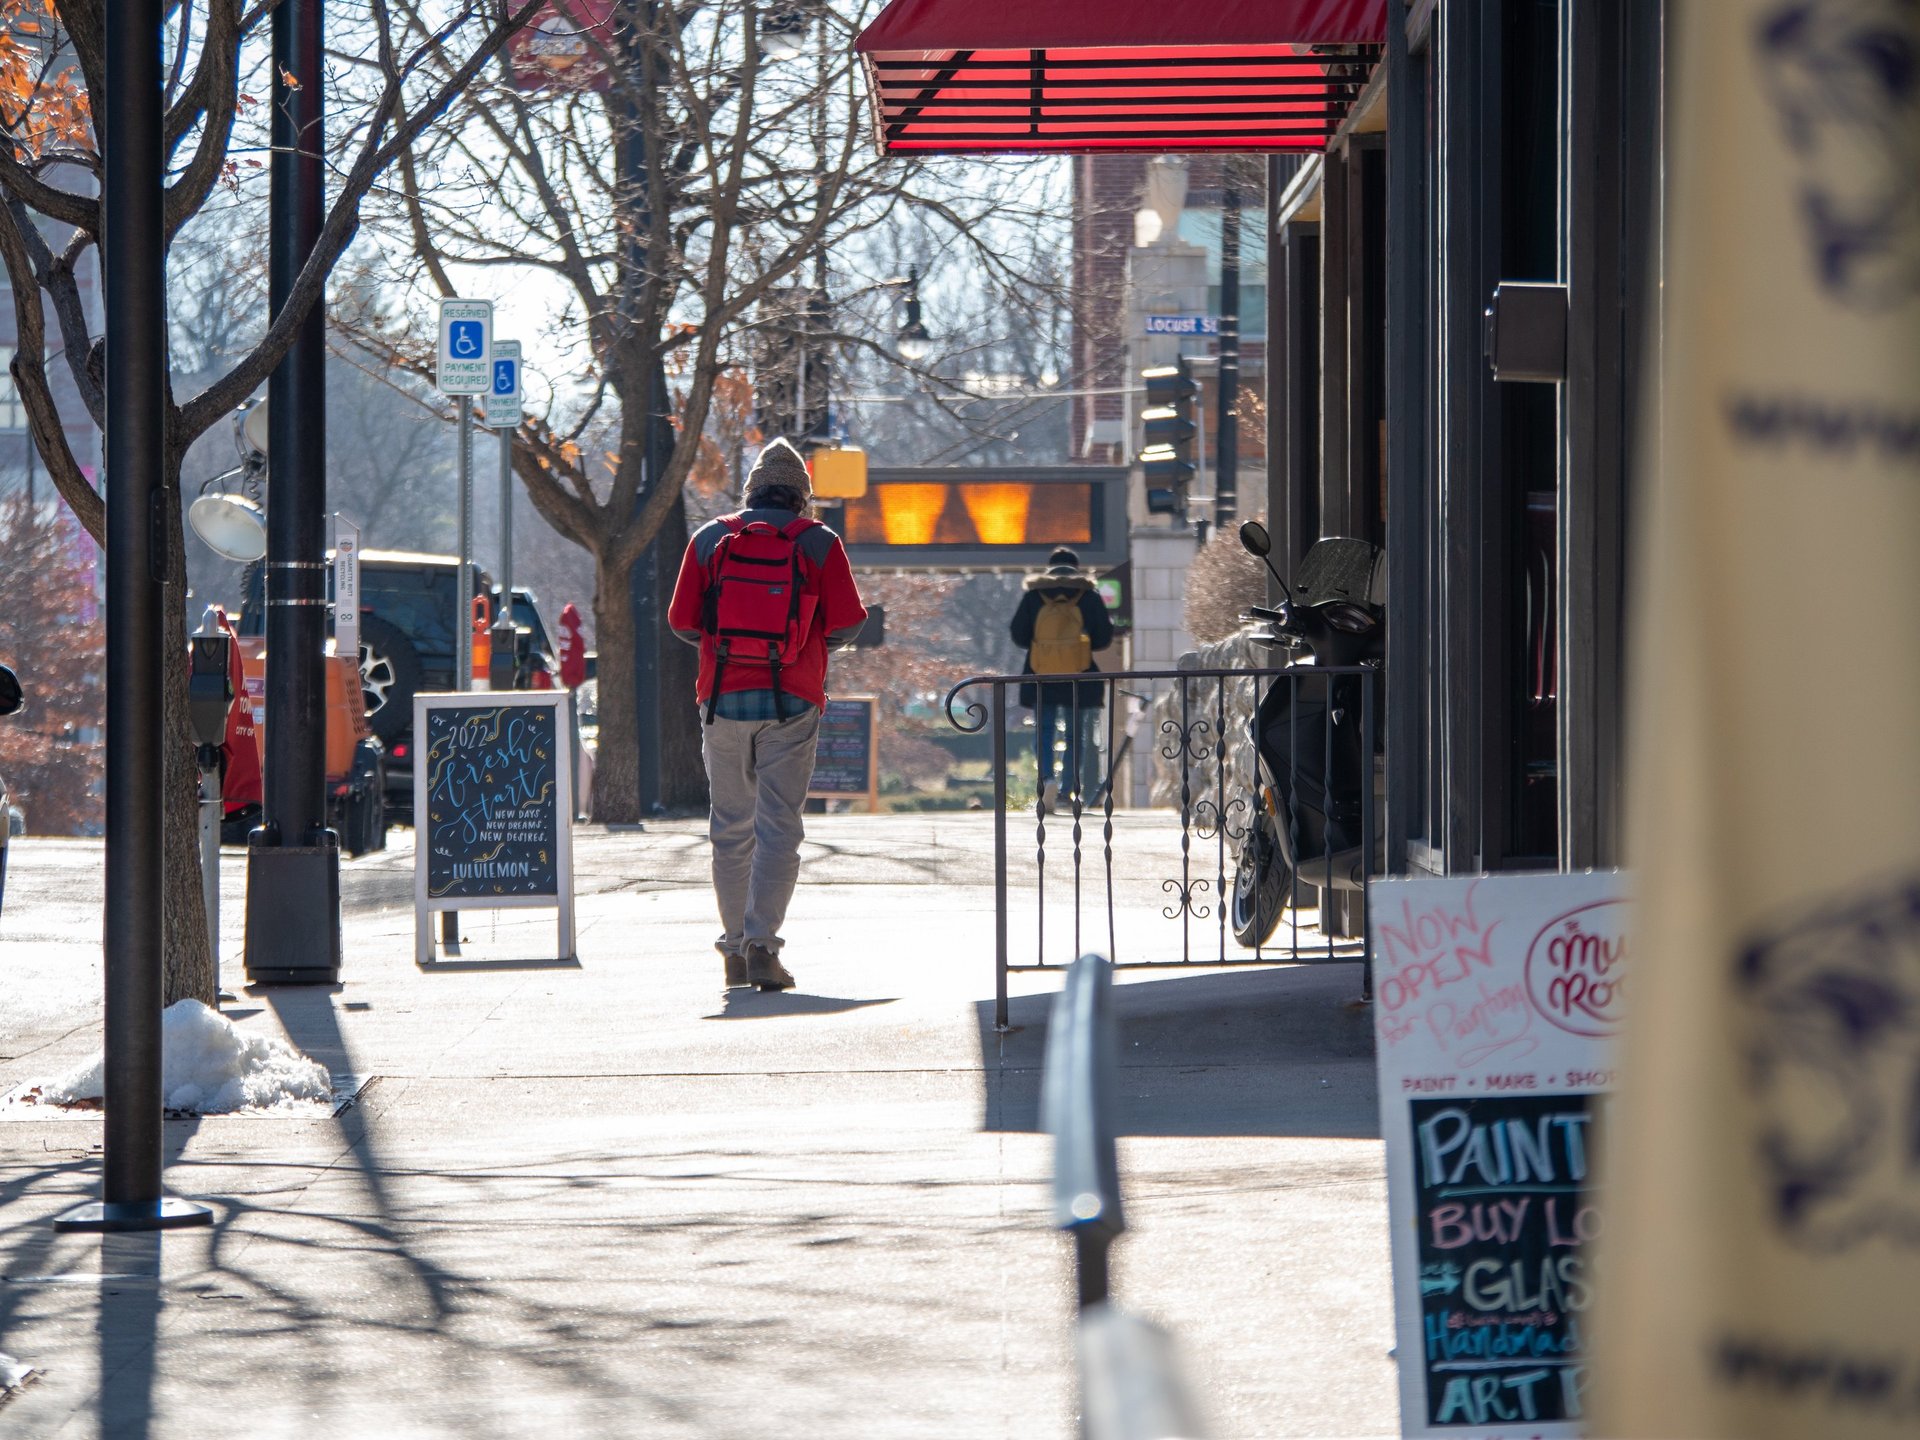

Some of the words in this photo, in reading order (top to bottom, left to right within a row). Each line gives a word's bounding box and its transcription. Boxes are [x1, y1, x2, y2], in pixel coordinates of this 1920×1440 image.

[443, 309, 488, 318] RESERVED
[445, 363, 486, 373] PAYMENT
[443, 376, 487, 385] REQUIRED
[448, 725, 488, 749] 2022
[435, 764, 546, 844] start
[495, 810, 515, 819] NEW
[480, 831, 502, 841] NEW
[486, 822, 506, 830] NEW
[1379, 880, 1481, 966] NOW
[1379, 917, 1503, 1011] OPEN
[1402, 1075, 1457, 1092] PAINT
[1485, 1073, 1537, 1090] MAKE
[1418, 1107, 1591, 1189] PAINT
[1429, 1197, 1530, 1249] BUY
[1435, 1368, 1548, 1426] ART
